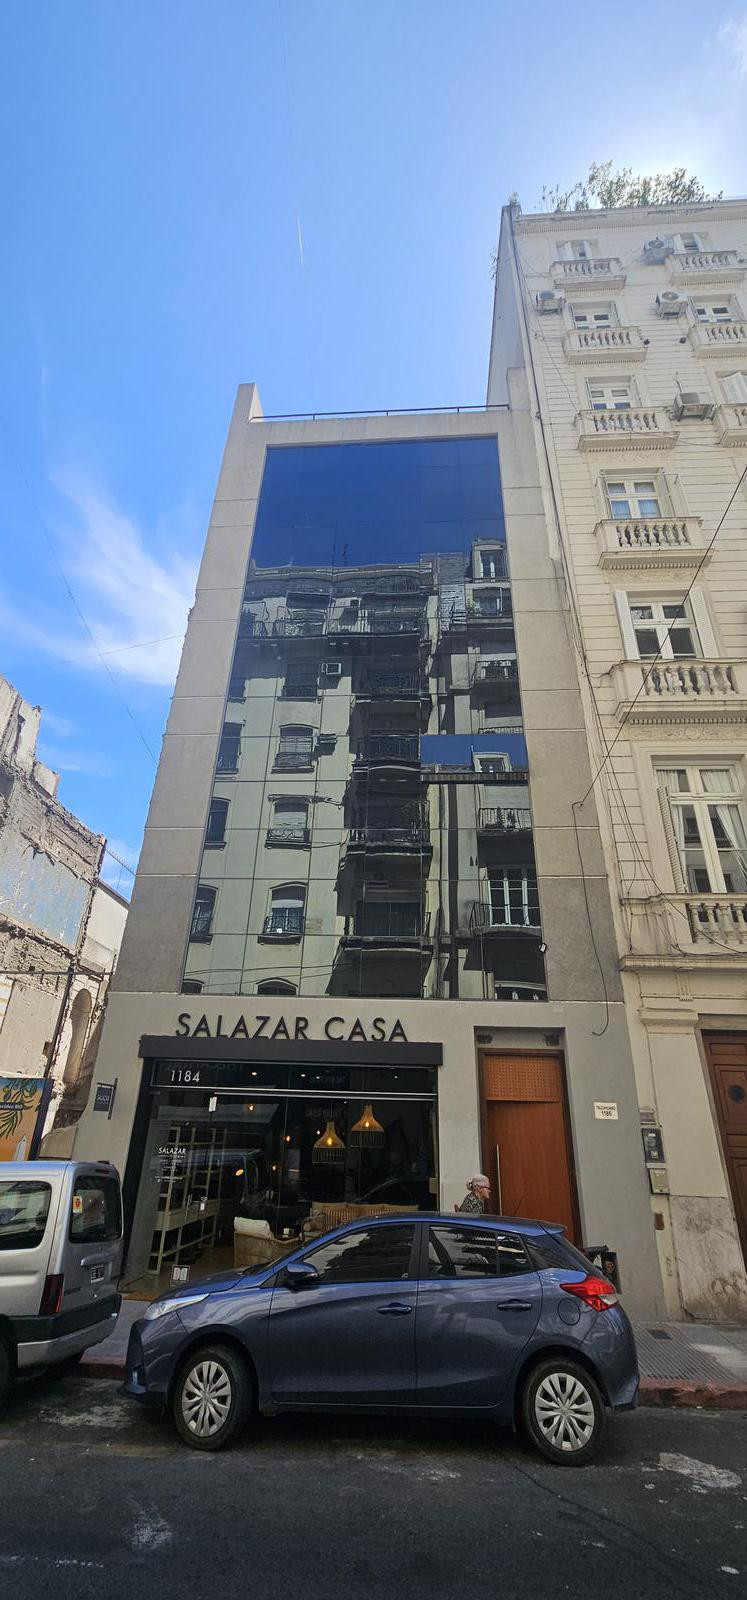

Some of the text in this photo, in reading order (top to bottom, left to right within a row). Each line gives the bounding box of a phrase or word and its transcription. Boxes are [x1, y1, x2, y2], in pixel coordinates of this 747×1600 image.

[175, 1013, 409, 1042] SALAZAR CASA
[170, 1070, 201, 1082] 1184
[158, 1147, 187, 1155] SALAZAR
